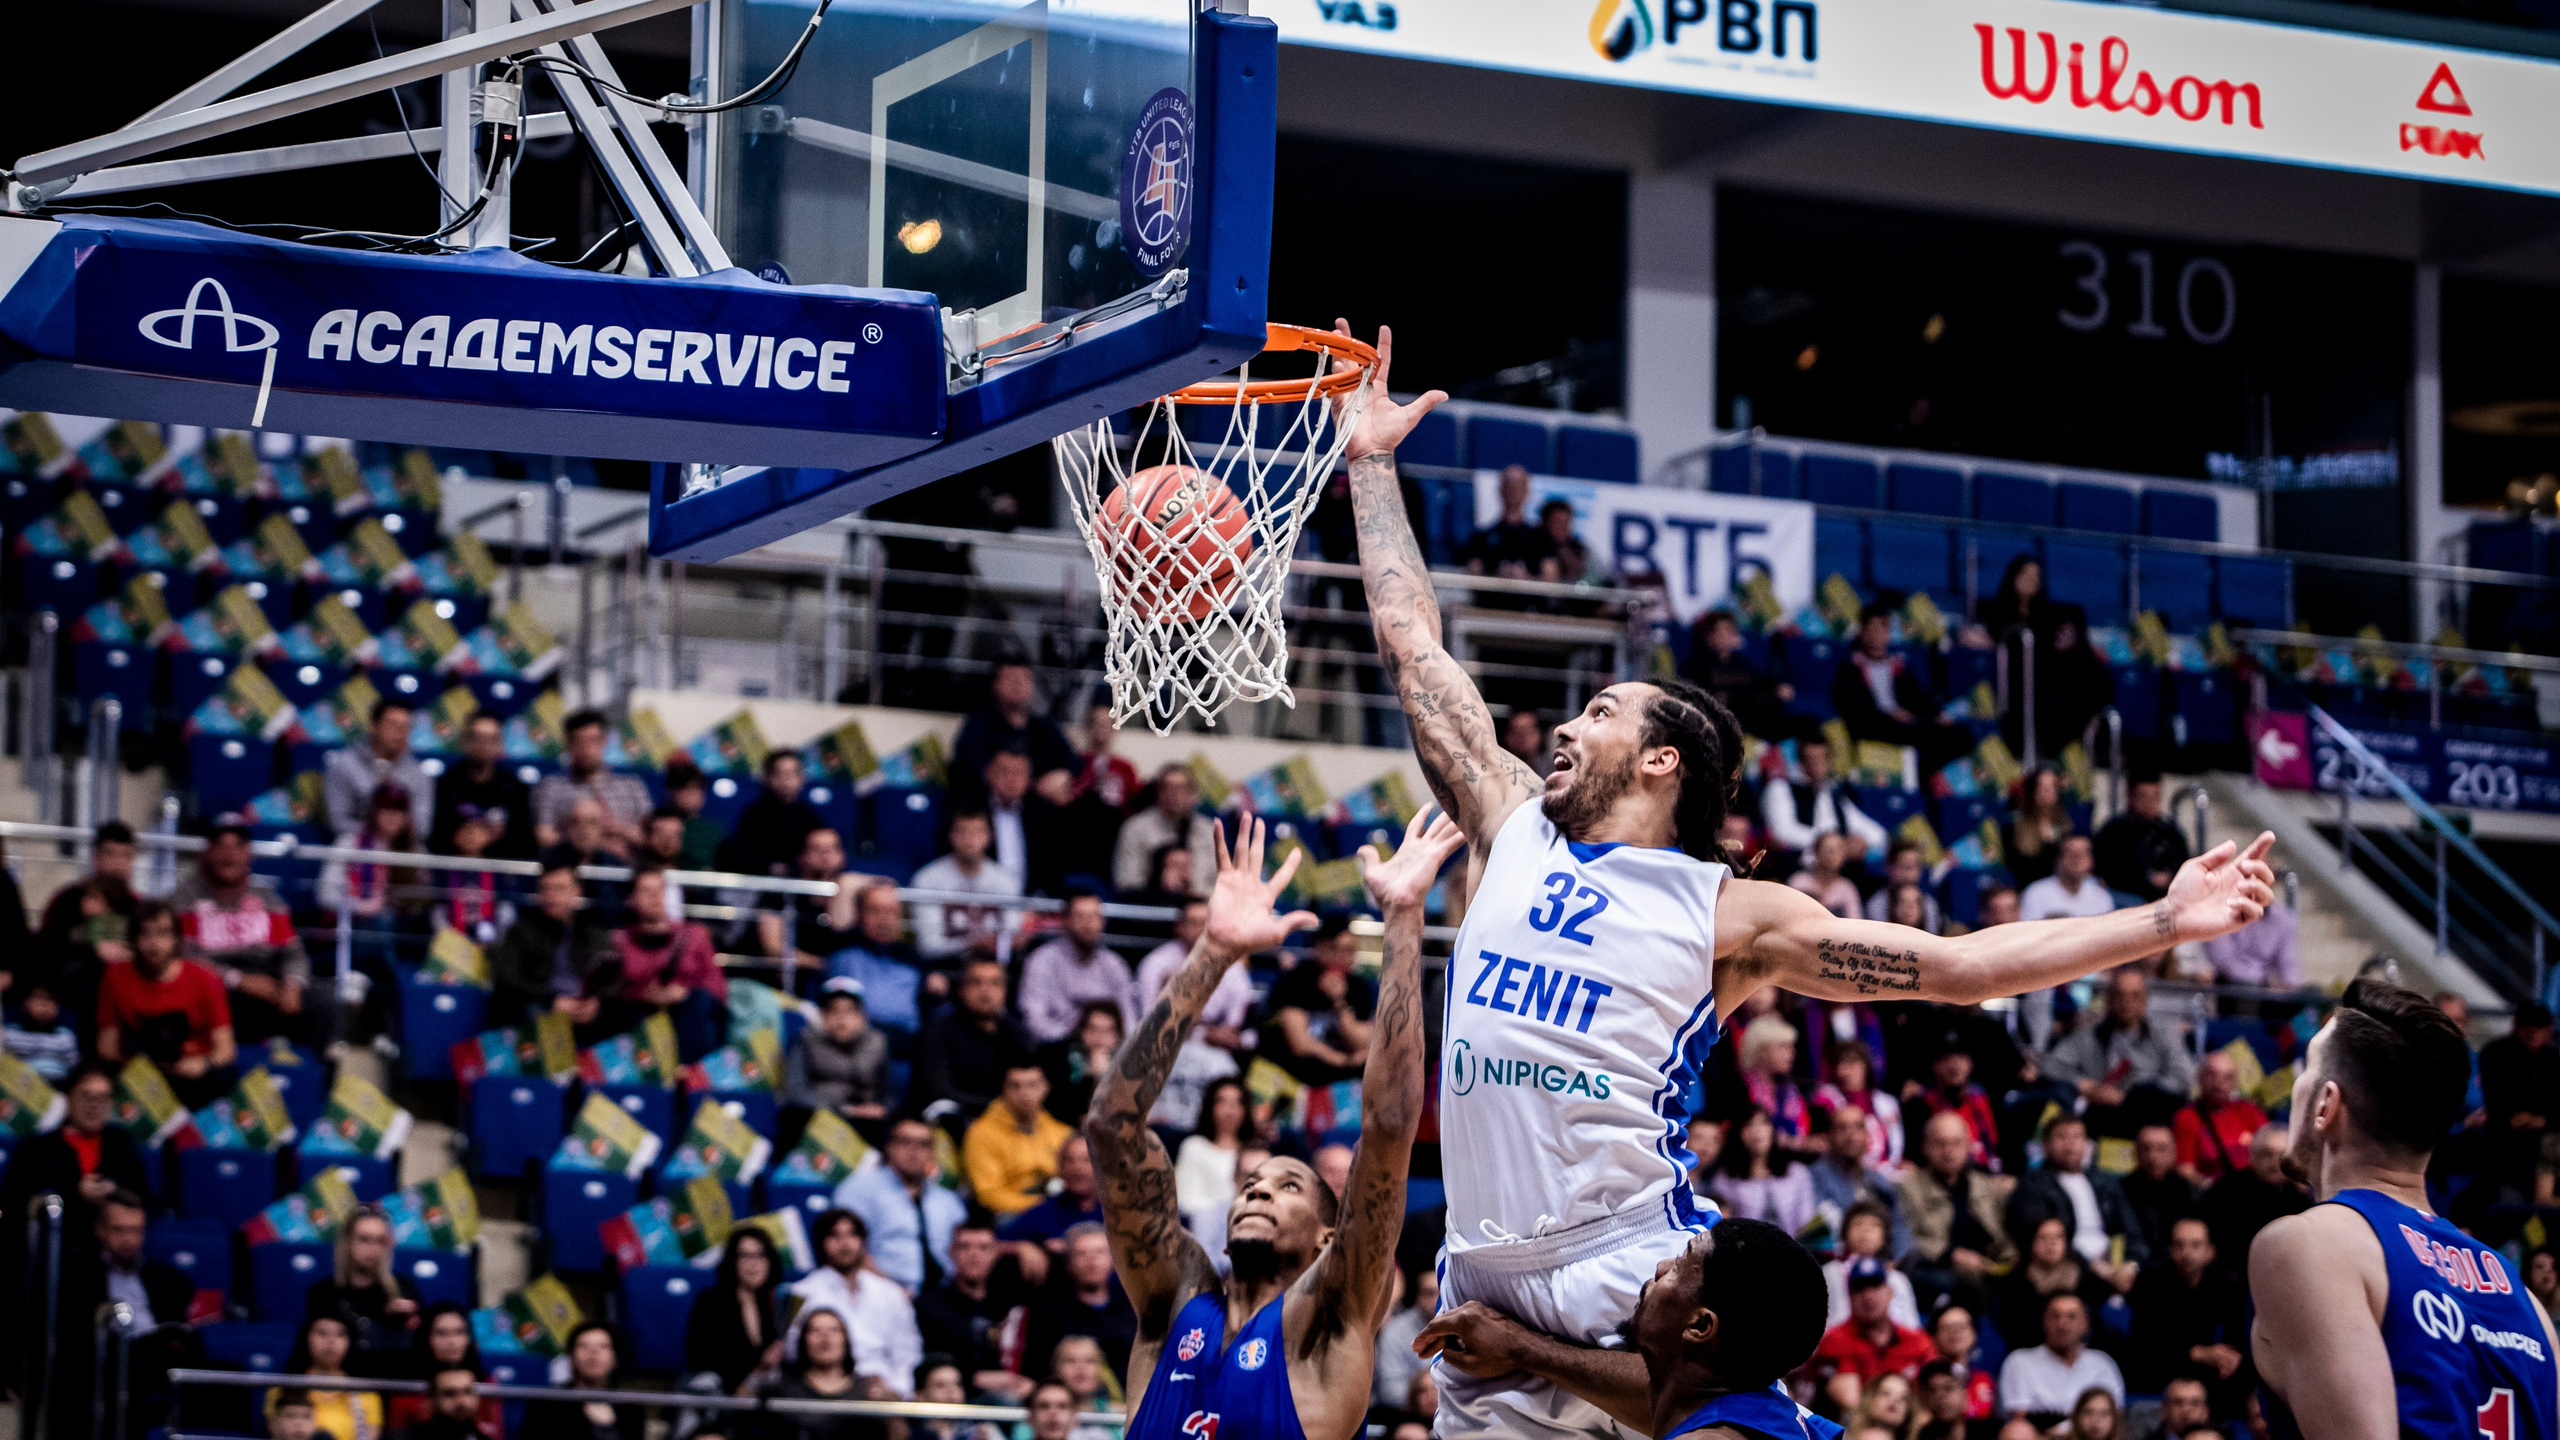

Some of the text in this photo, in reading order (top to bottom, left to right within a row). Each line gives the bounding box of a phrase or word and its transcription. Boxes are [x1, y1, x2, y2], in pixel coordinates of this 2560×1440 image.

[1973, 22, 2265, 130] Wilson
[1129, 128, 1142, 155] VTB
[1141, 97, 1169, 128] UNITED
[1137, 247, 1159, 267] FINAL
[2056, 240, 2237, 345] 310
[1611, 511, 1774, 600] ВТБ
[2447, 759, 2519, 806] 203
[1528, 871, 1610, 947] 32
[1466, 949, 1614, 1035] ZENIT
[1483, 1056, 1612, 1101] NIPIGAS
[2477, 1386, 2515, 1440] 1
